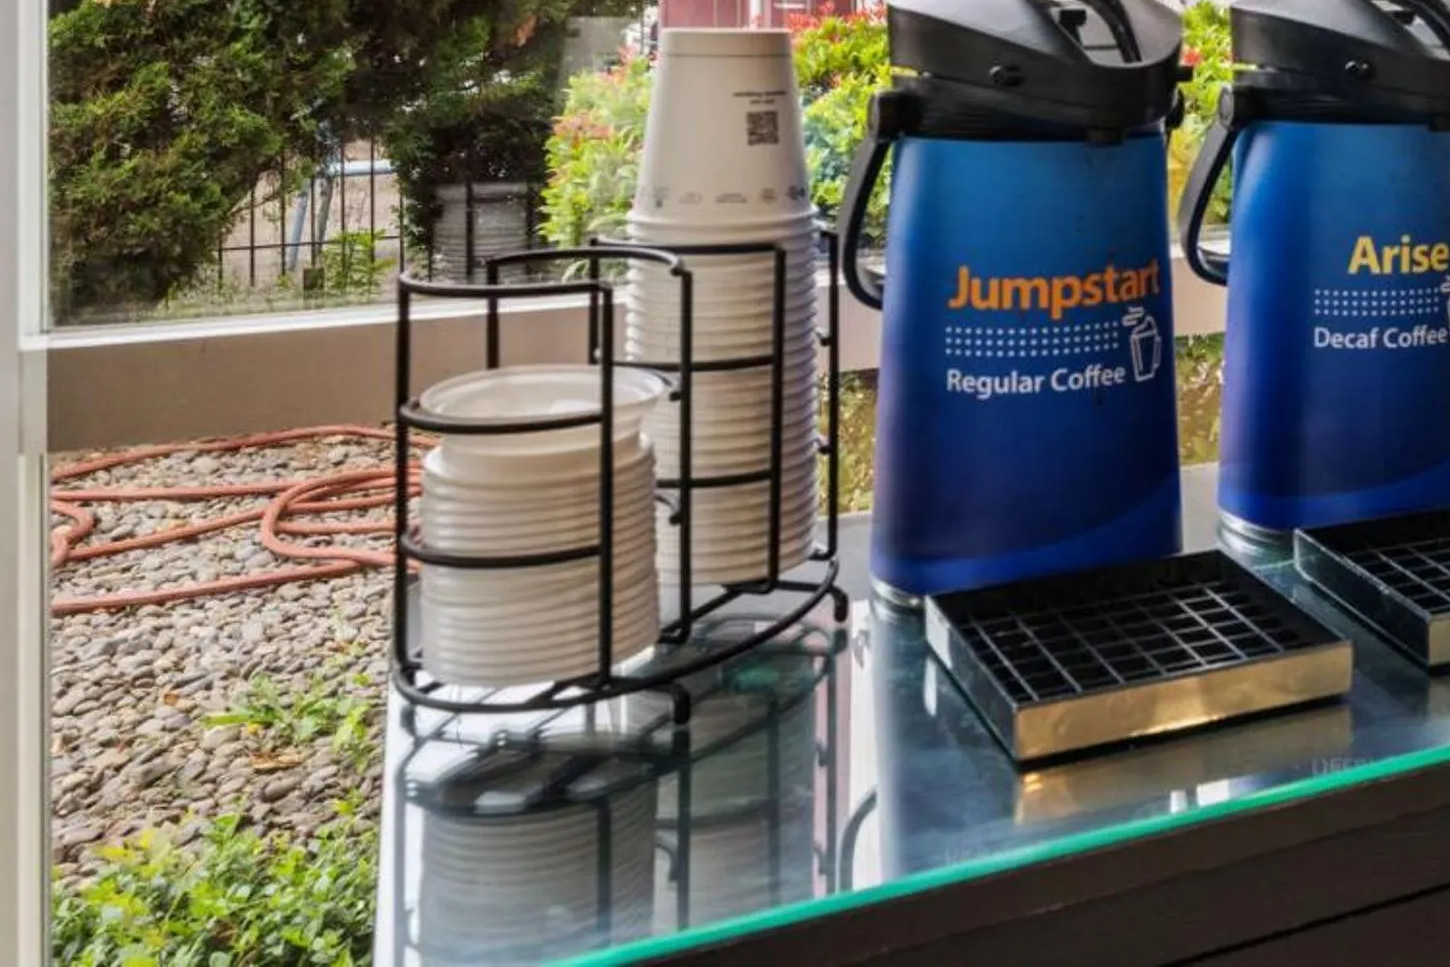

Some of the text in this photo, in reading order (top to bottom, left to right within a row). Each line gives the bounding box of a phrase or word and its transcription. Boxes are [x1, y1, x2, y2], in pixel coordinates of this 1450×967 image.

[1347, 234, 1450, 275] Arise
[947, 257, 1160, 321] Jumpstart
[1313, 324, 1448, 350] Decaf Coffee
[946, 363, 1126, 400] Regular Coffee
